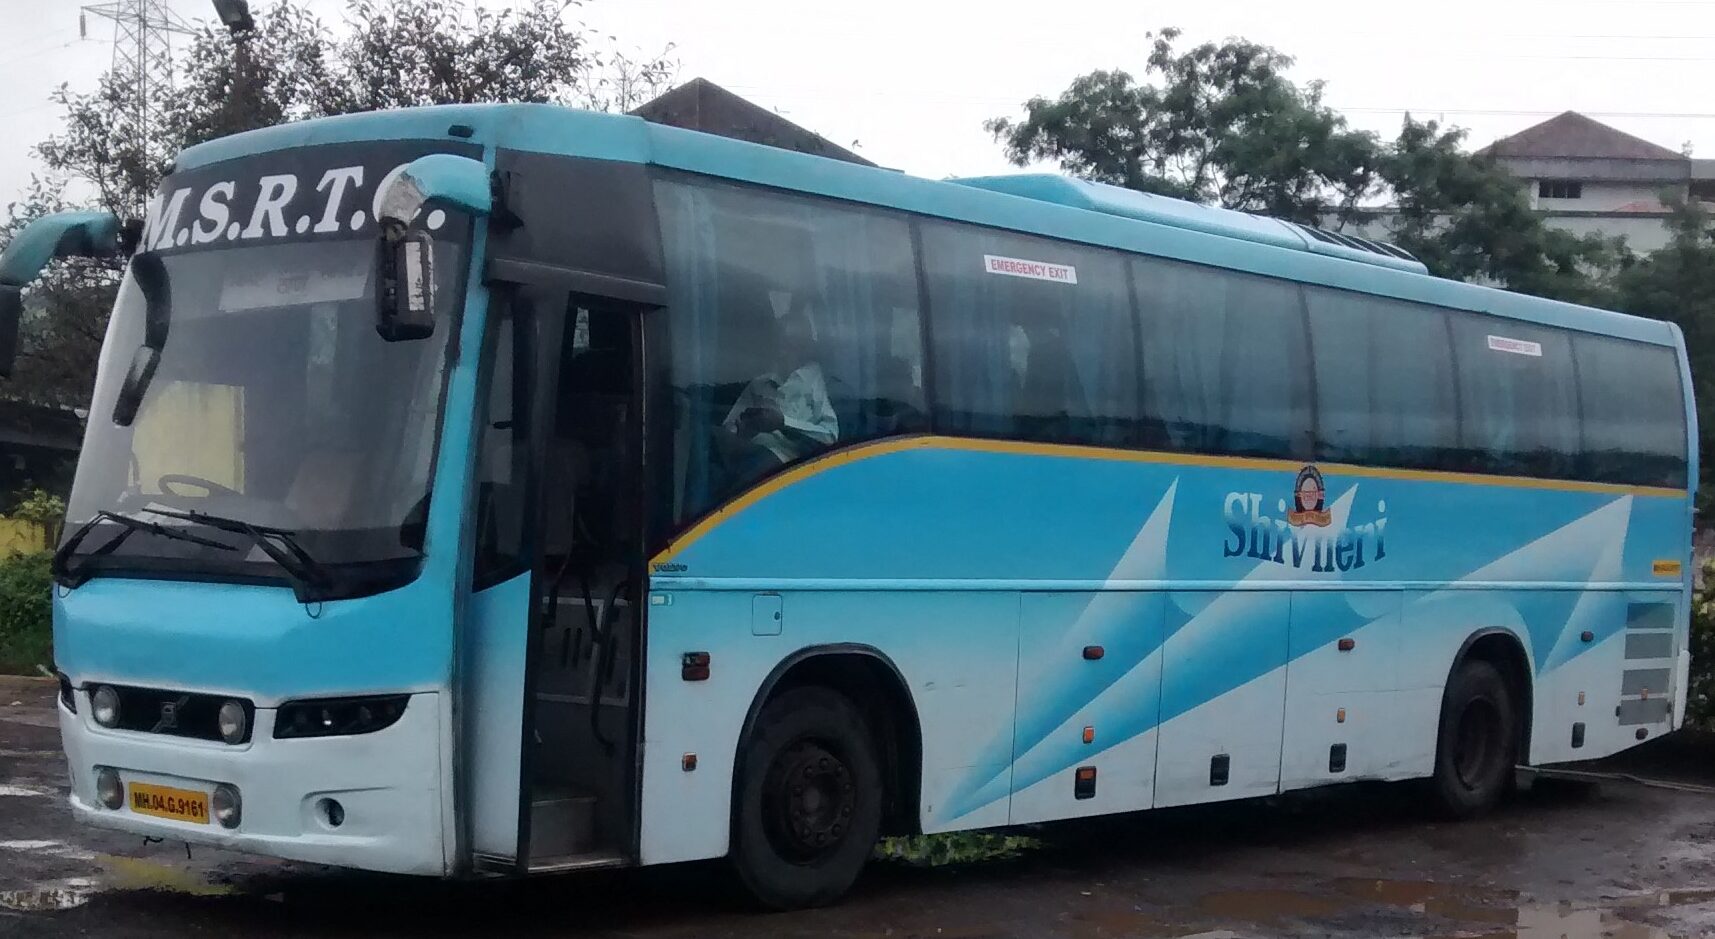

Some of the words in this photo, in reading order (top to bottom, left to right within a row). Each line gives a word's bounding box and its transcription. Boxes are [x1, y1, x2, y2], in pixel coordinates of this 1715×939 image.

[991, 259, 1046, 276] EMERGENCY
[1048, 267, 1068, 279] EXIT
[1223, 491, 1388, 573] Shivneri
